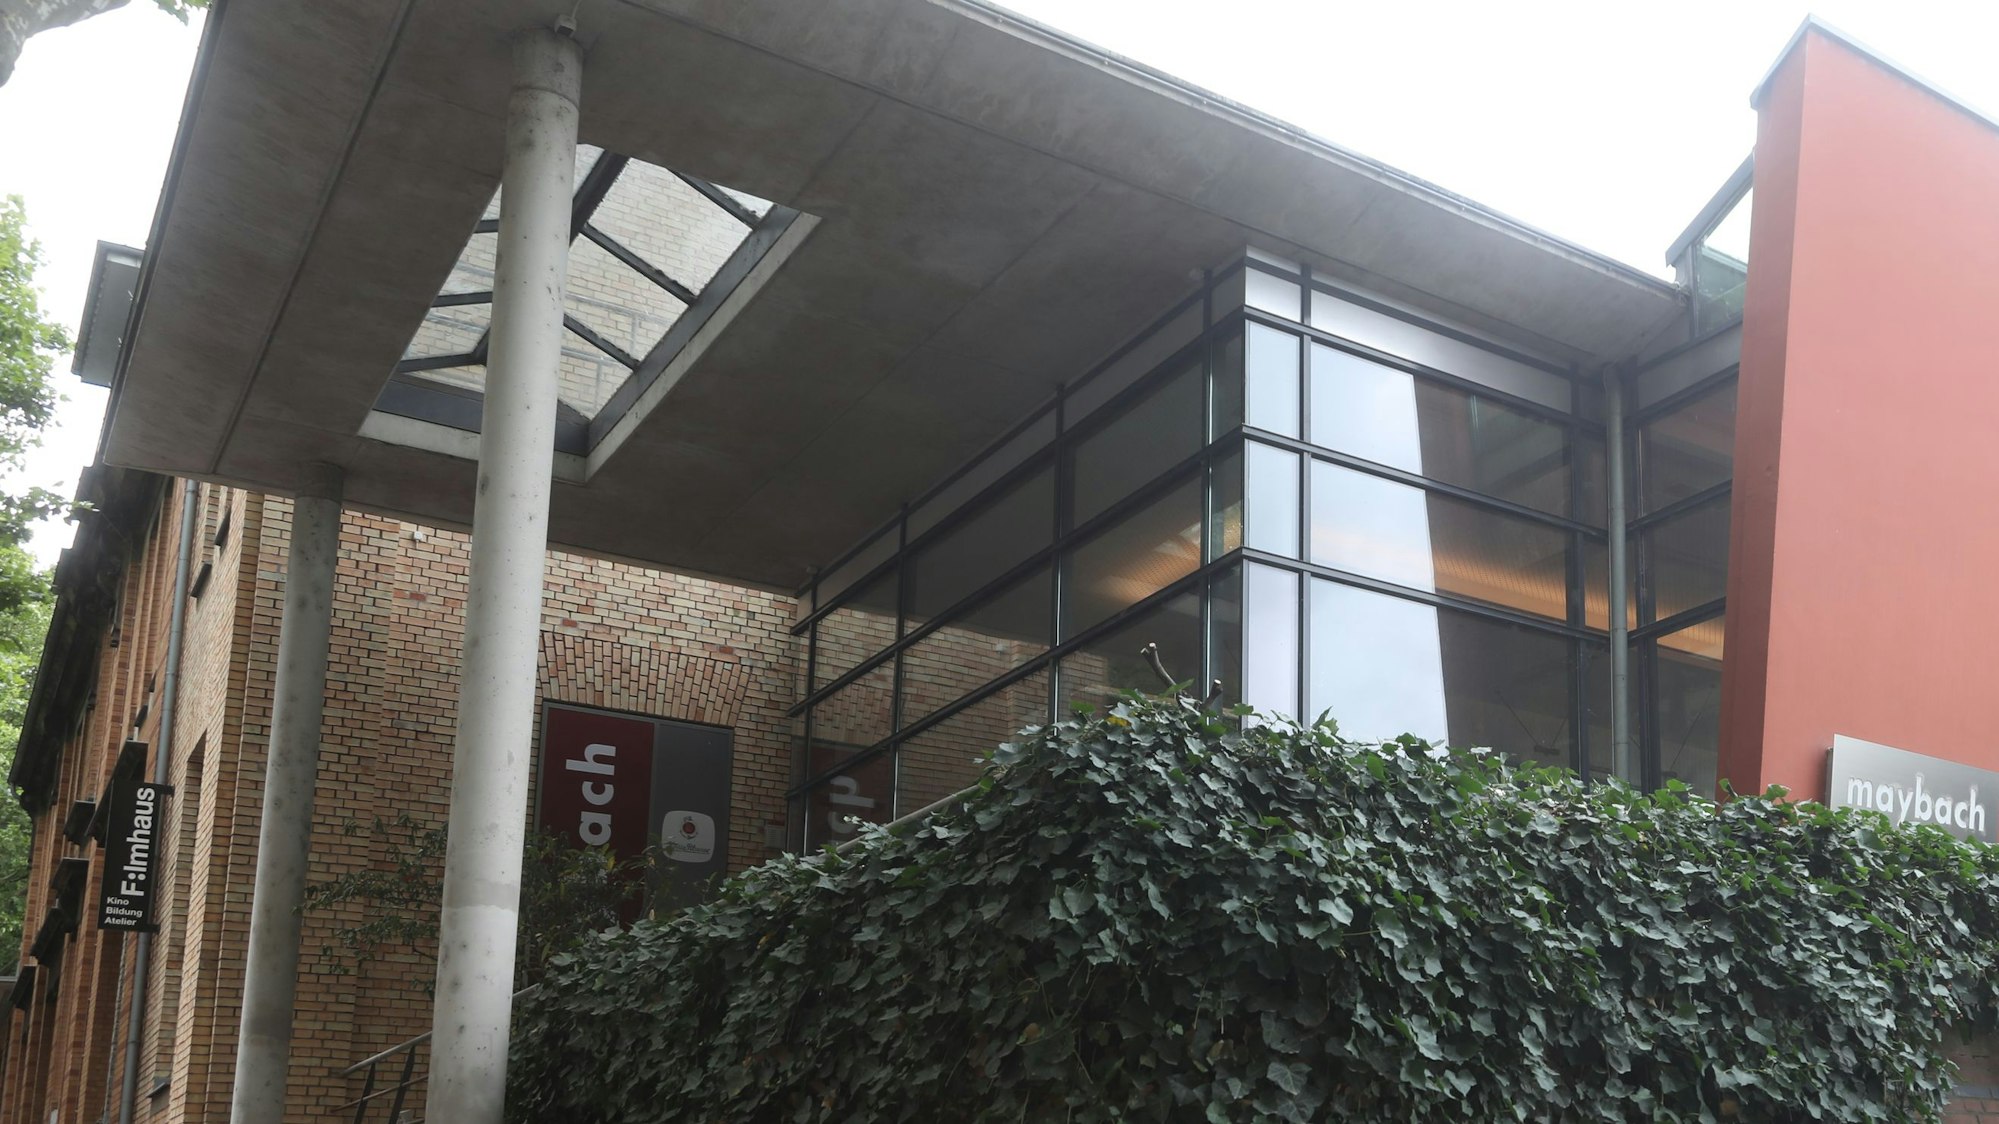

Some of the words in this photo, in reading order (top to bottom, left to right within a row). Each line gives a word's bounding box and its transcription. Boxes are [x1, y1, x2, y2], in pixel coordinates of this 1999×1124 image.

[1848, 775, 1986, 832] maybach
[121, 787, 155, 896] F:lmhaus
[106, 896, 130, 905] Kino
[105, 906, 143, 918] Bildung
[104, 917, 137, 926] Atelier
